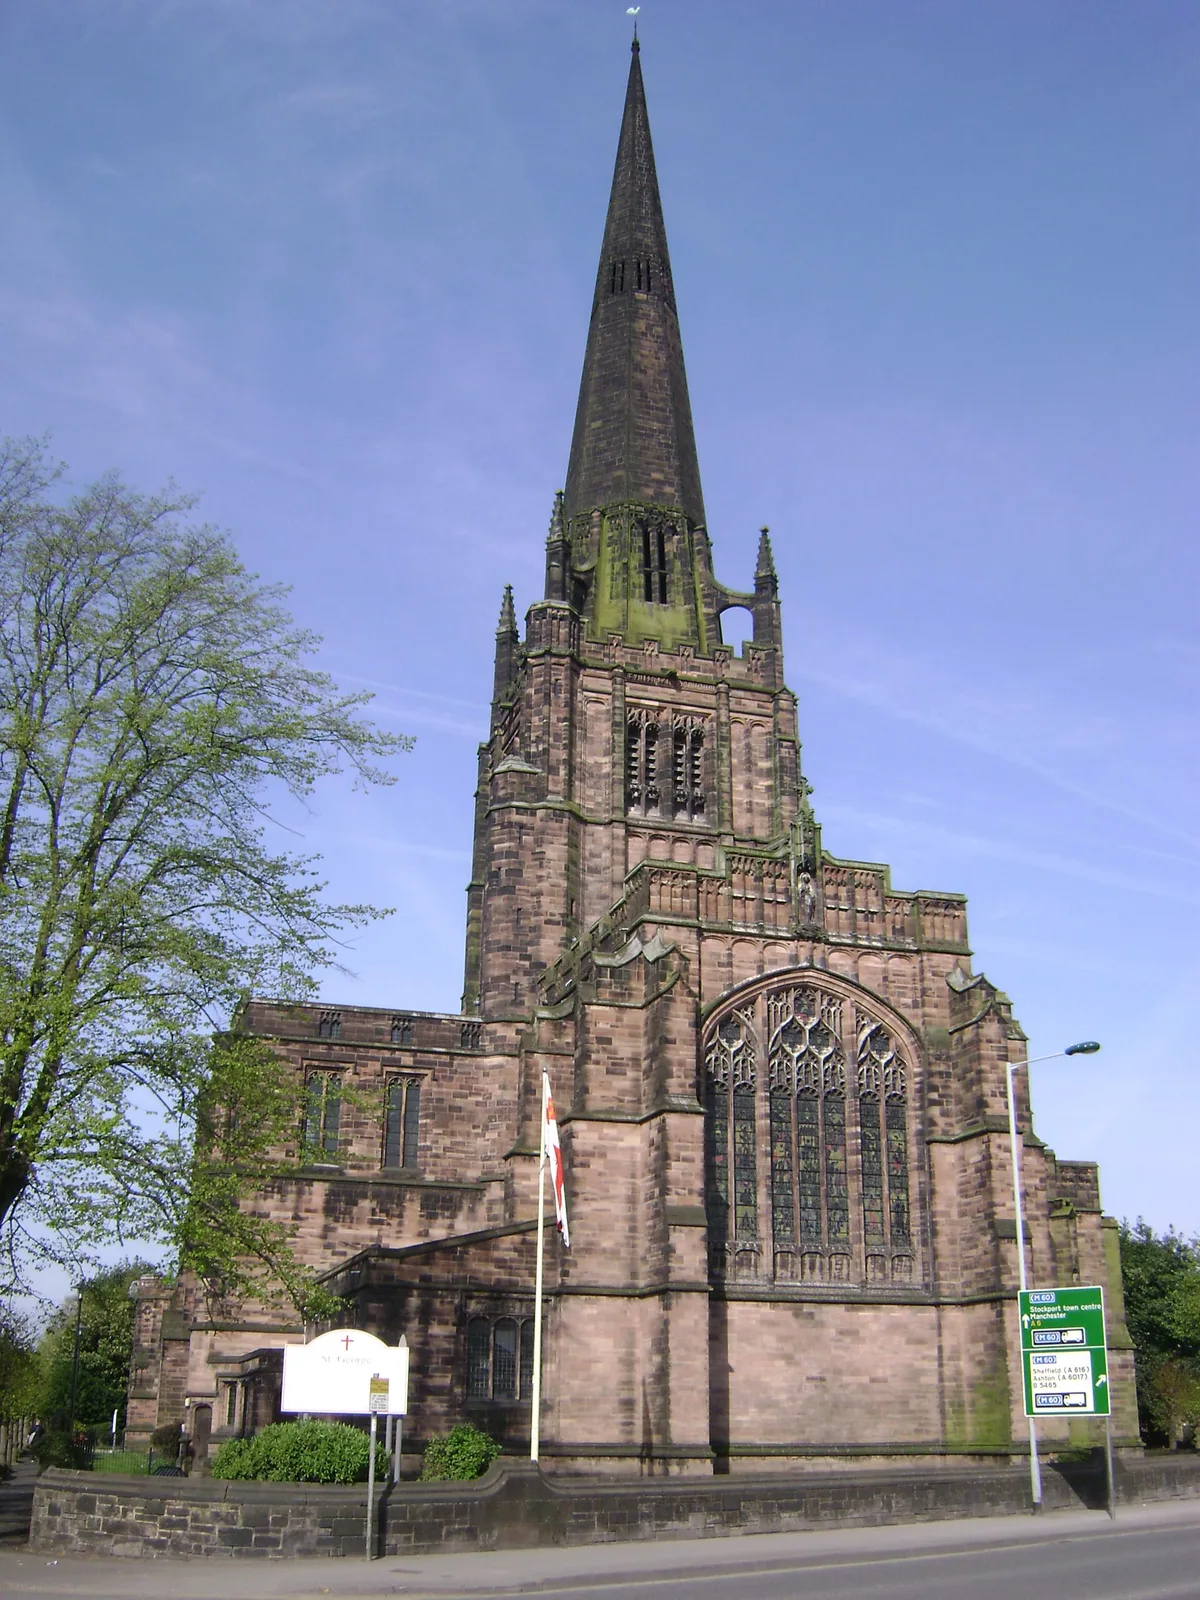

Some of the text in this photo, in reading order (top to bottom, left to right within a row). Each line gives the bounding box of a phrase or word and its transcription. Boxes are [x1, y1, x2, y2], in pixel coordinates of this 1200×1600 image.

[1030, 1305, 1061, 1313] Stockport
[1080, 1303, 1102, 1311] centre
[1030, 1312, 1066, 1320] Manchester
[1068, 1373, 1088, 1381] 6017)
